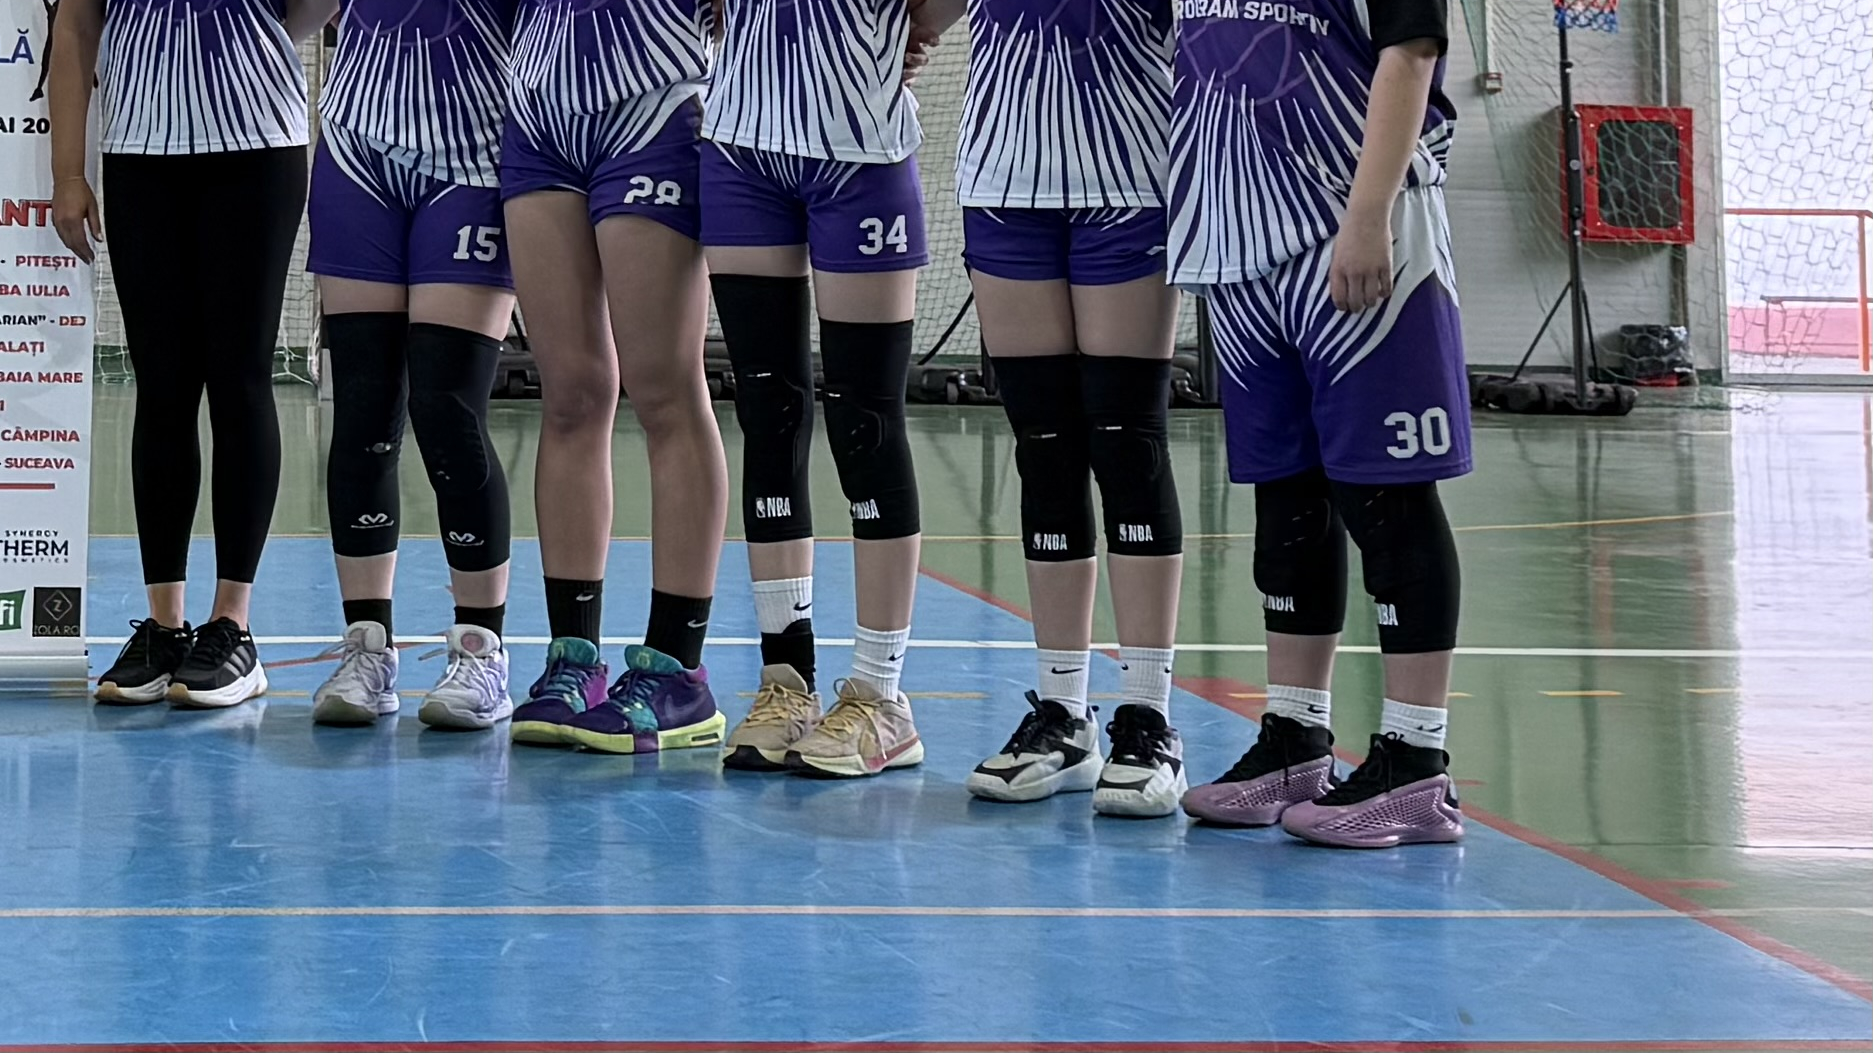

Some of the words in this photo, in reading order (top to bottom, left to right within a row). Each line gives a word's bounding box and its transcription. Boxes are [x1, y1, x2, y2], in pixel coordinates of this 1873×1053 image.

[22, 116, 50, 134] 20
[623, 174, 683, 206] 28
[452, 224, 502, 263] 15
[857, 214, 909, 256] 34
[15, 255, 77, 271] PITEȘTI
[26, 284, 71, 297] IULIA
[58, 315, 87, 327] DEJ
[37, 372, 84, 384] MARE
[0, 426, 81, 443] CÂMPINA
[1384, 406, 1453, 459] 30
[4, 457, 75, 469] SUCEAVA
[767, 497, 792, 518] NBA
[1042, 533, 1068, 551] NBA
[1128, 524, 1154, 542] NBA
